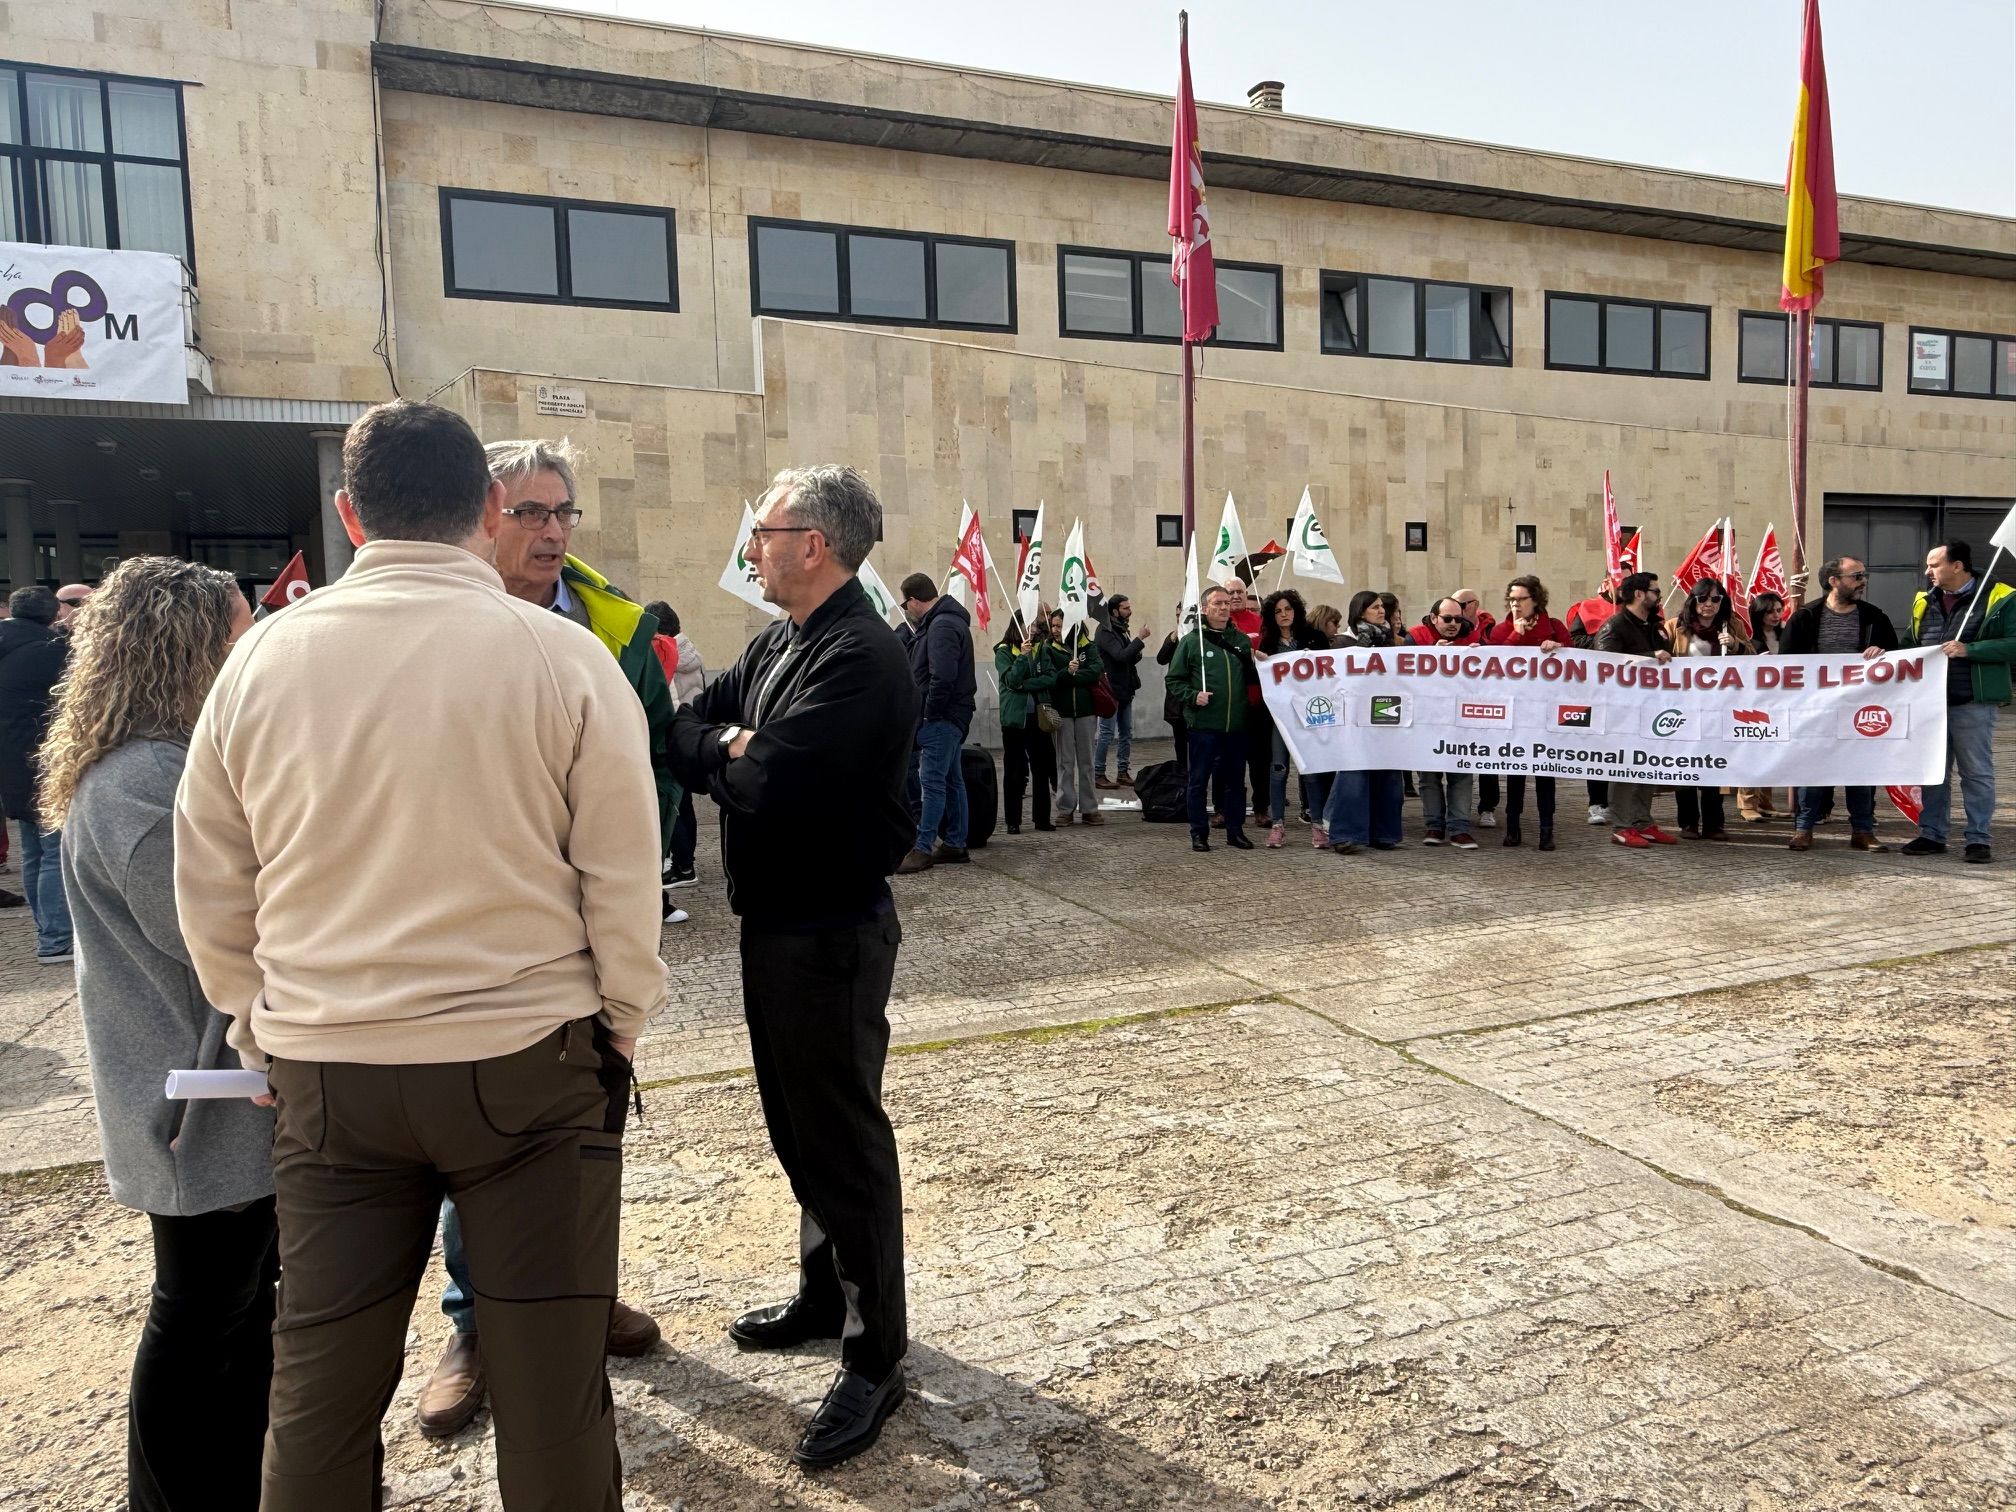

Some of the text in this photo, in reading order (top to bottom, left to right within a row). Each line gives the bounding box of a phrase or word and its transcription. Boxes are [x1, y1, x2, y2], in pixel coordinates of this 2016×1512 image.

[1273, 653, 1924, 690] POR LA EDUCACIÓN PÚBLICA DE LEÓN
[1464, 706, 1503, 717] CCOO
[1563, 711, 1587, 721] CGT
[1858, 710, 1887, 723] UGT
[1306, 713, 1335, 725] ANPE
[1658, 716, 1687, 729] CSIF
[1734, 726, 1779, 740] STECyL-i
[1433, 740, 1728, 769] Junta de Personal Docente
[1457, 759, 1700, 781] de centros públicos no univesitarios
